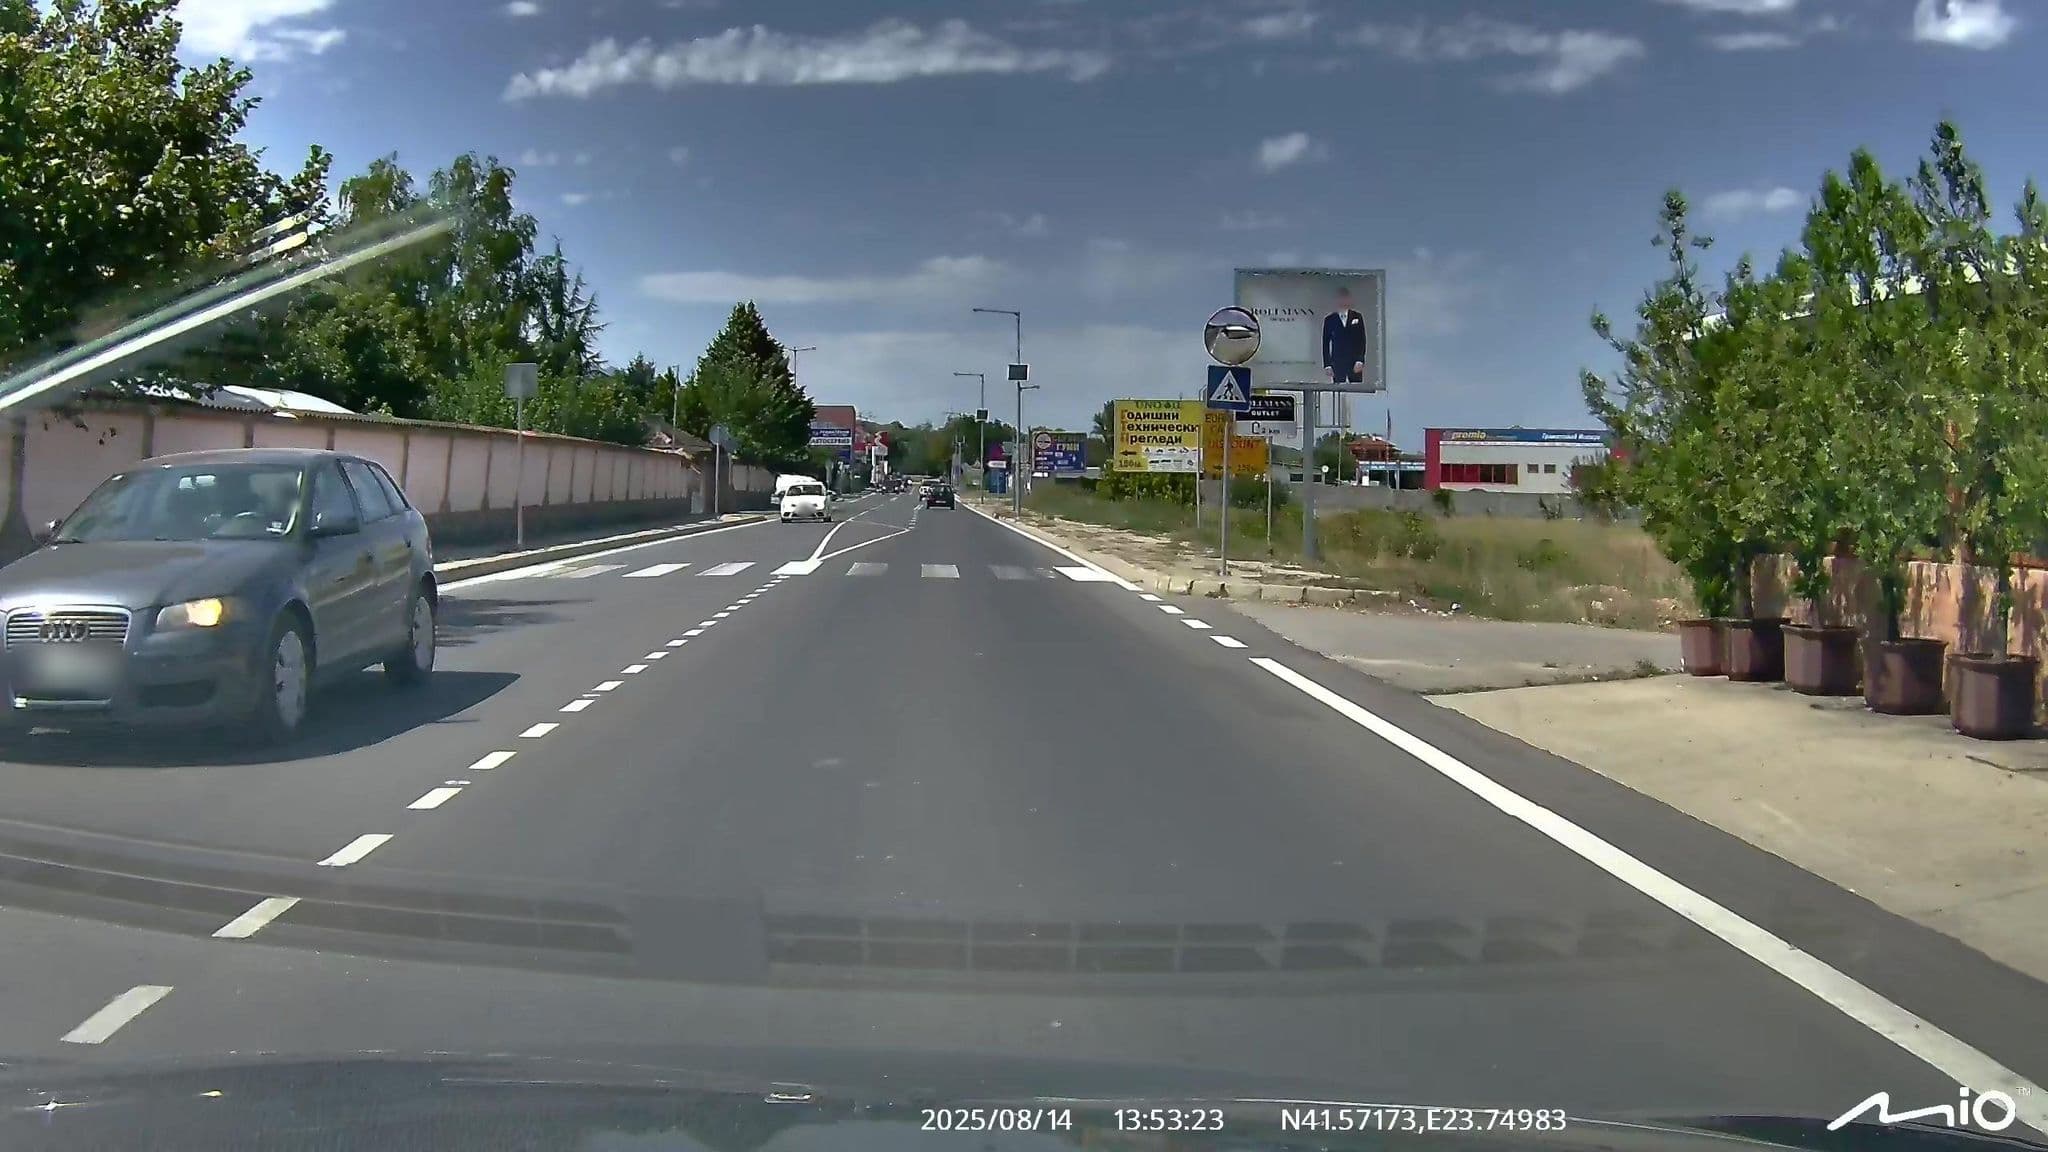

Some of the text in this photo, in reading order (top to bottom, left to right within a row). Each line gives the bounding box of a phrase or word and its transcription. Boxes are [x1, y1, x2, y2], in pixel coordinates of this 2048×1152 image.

[1120, 409, 1180, 422] Годишни
[1120, 431, 1183, 446] Прегледи
[1451, 430, 1487, 441] premio
